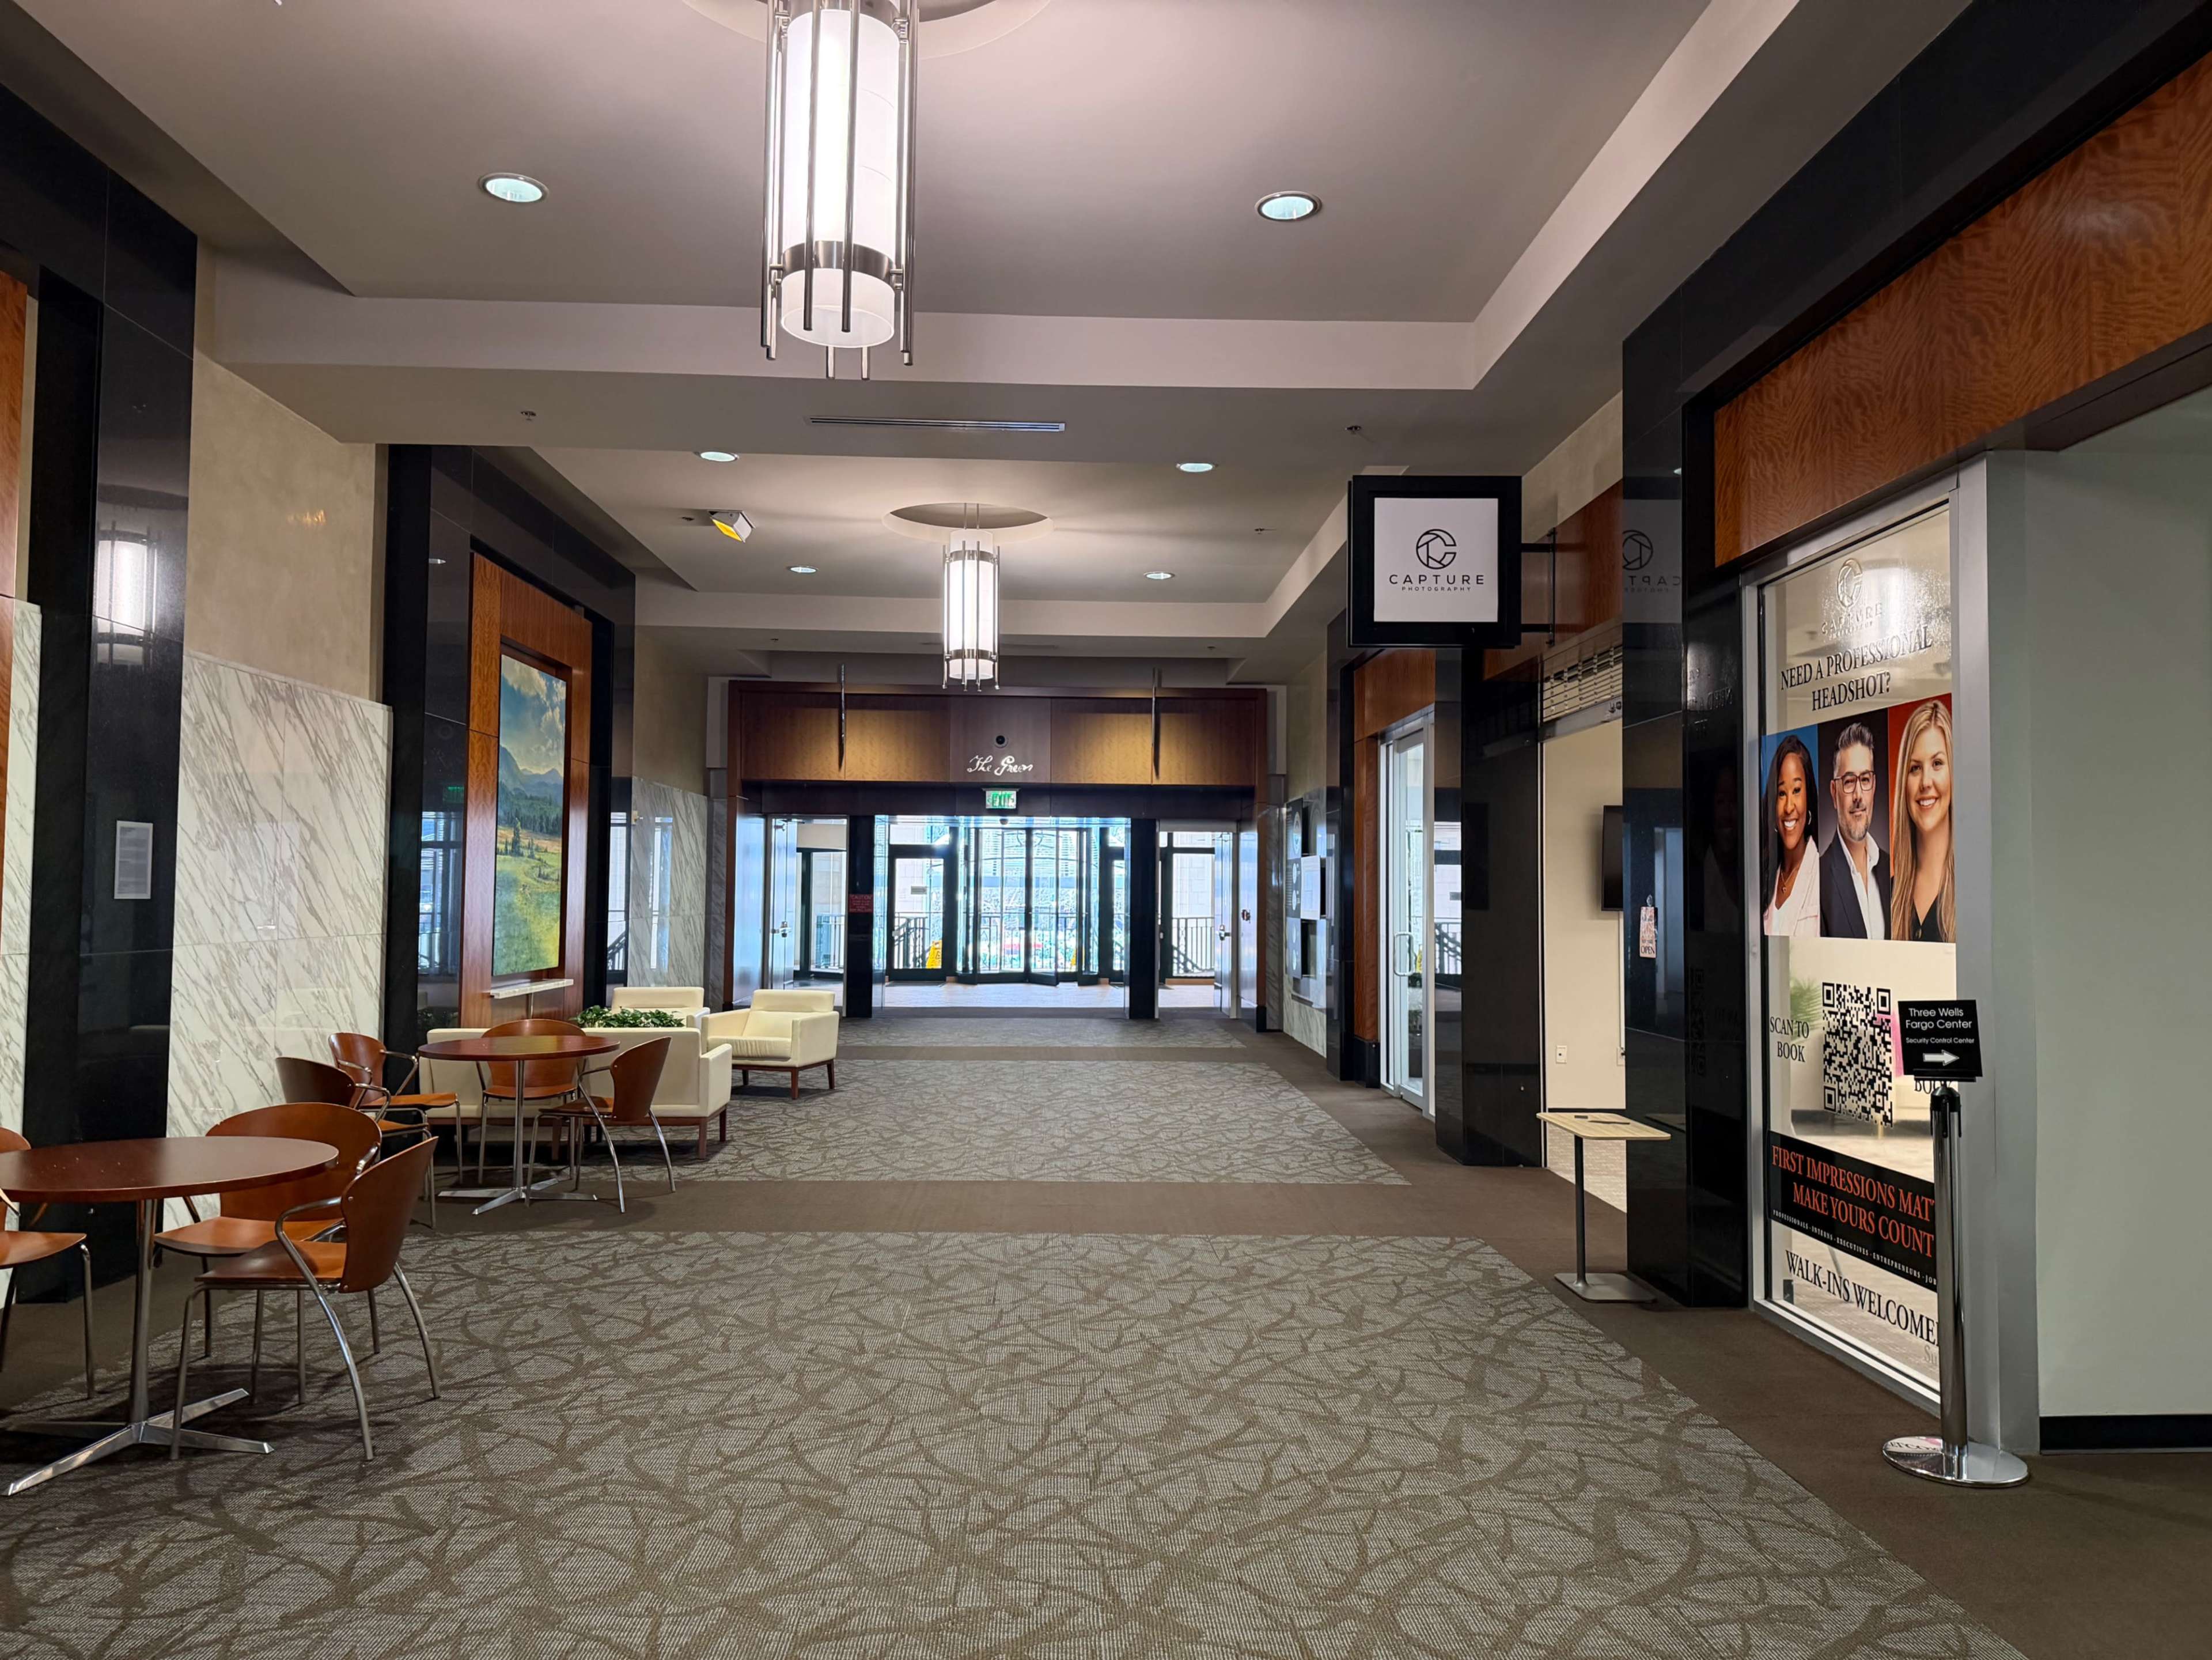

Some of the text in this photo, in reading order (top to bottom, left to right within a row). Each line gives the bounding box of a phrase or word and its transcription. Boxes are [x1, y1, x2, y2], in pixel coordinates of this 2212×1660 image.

[1389, 574, 1484, 585] CAPTURE
[1781, 663, 1812, 690] NEED
[1815, 659, 1824, 680] A
[1827, 625, 1933, 677] PROFESSIONAL
[1812, 671, 1891, 711] HEADSHOT?
[967, 755, 1033, 776] The Green
[992, 792, 1012, 807] EXIT
[1908, 1007, 1964, 1017] Three Wells
[1770, 1016, 1809, 1038] SCAN TO
[1906, 1019, 1972, 1030] Fargo Center
[1777, 1041, 1805, 1062] BOOK
[1772, 1145, 1936, 1222] FIRST IMPRESSIONS MAT
[1793, 1182, 1934, 1258] MAKE YOURS COUNT
[1773, 1209, 1809, 1229] PROFESSIONALS
[1812, 1226, 1833, 1241] INTERNS
[1836, 1237, 1869, 1256] EXECUTIVES
[1873, 1252, 1921, 1279] ENTREPRENEURS
[1785, 1249, 1850, 1302] WALK-INS
